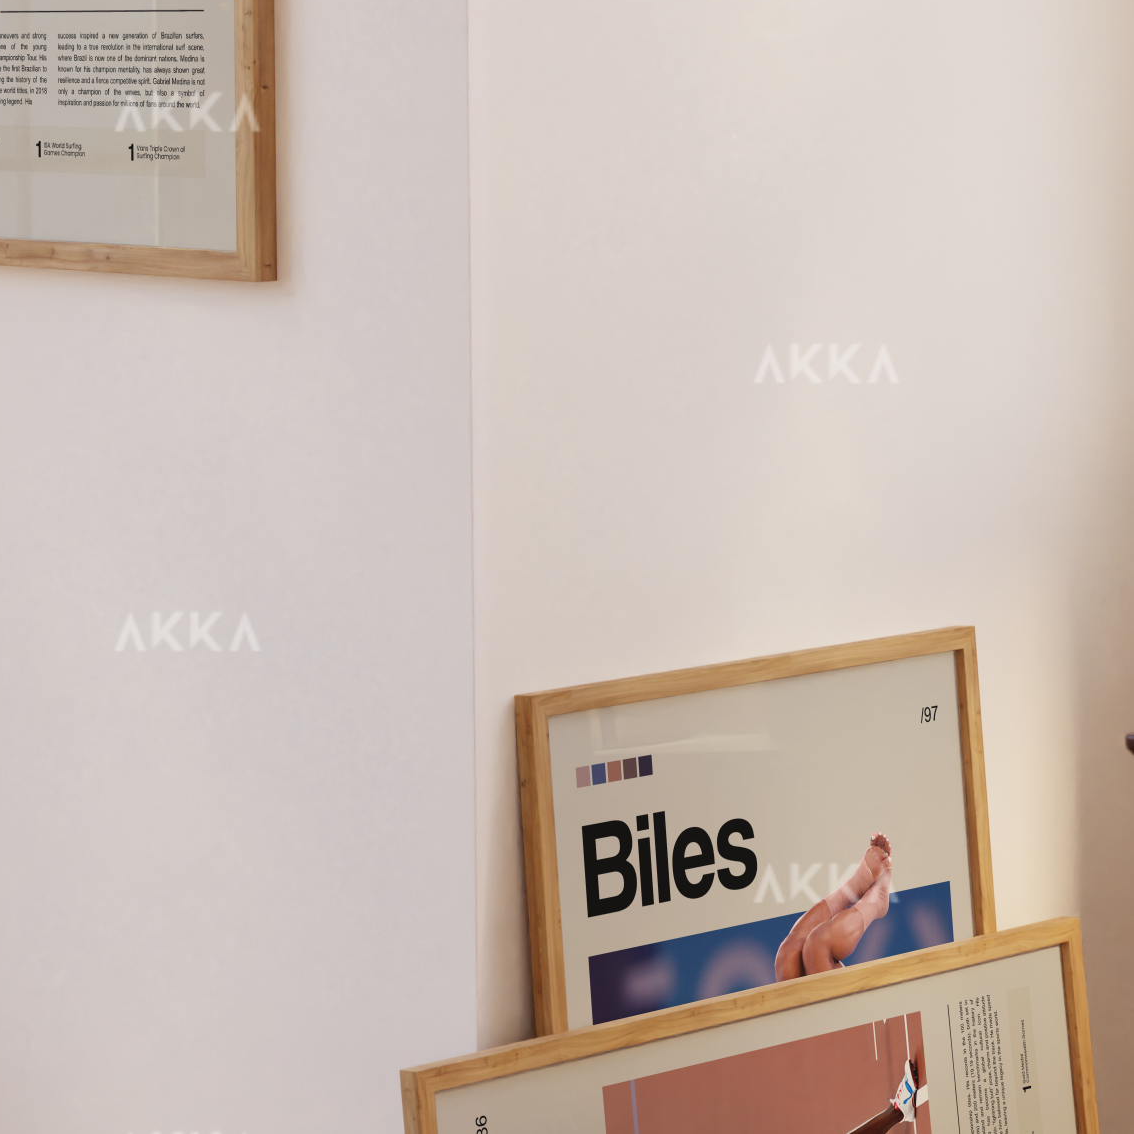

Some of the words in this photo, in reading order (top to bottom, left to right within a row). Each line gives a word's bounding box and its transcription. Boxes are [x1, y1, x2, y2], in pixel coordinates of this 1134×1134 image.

[32, 32, 47, 40] strong
[80, 32, 99, 40] inspired
[122, 32, 149, 41] generation
[186, 32, 204, 40] surfers,
[36, 140, 42, 158] 1
[128, 144, 134, 161] 1
[920, 705, 938, 724] /97
[582, 810, 758, 918] Biles
[1023, 1085, 1031, 1093] 1
